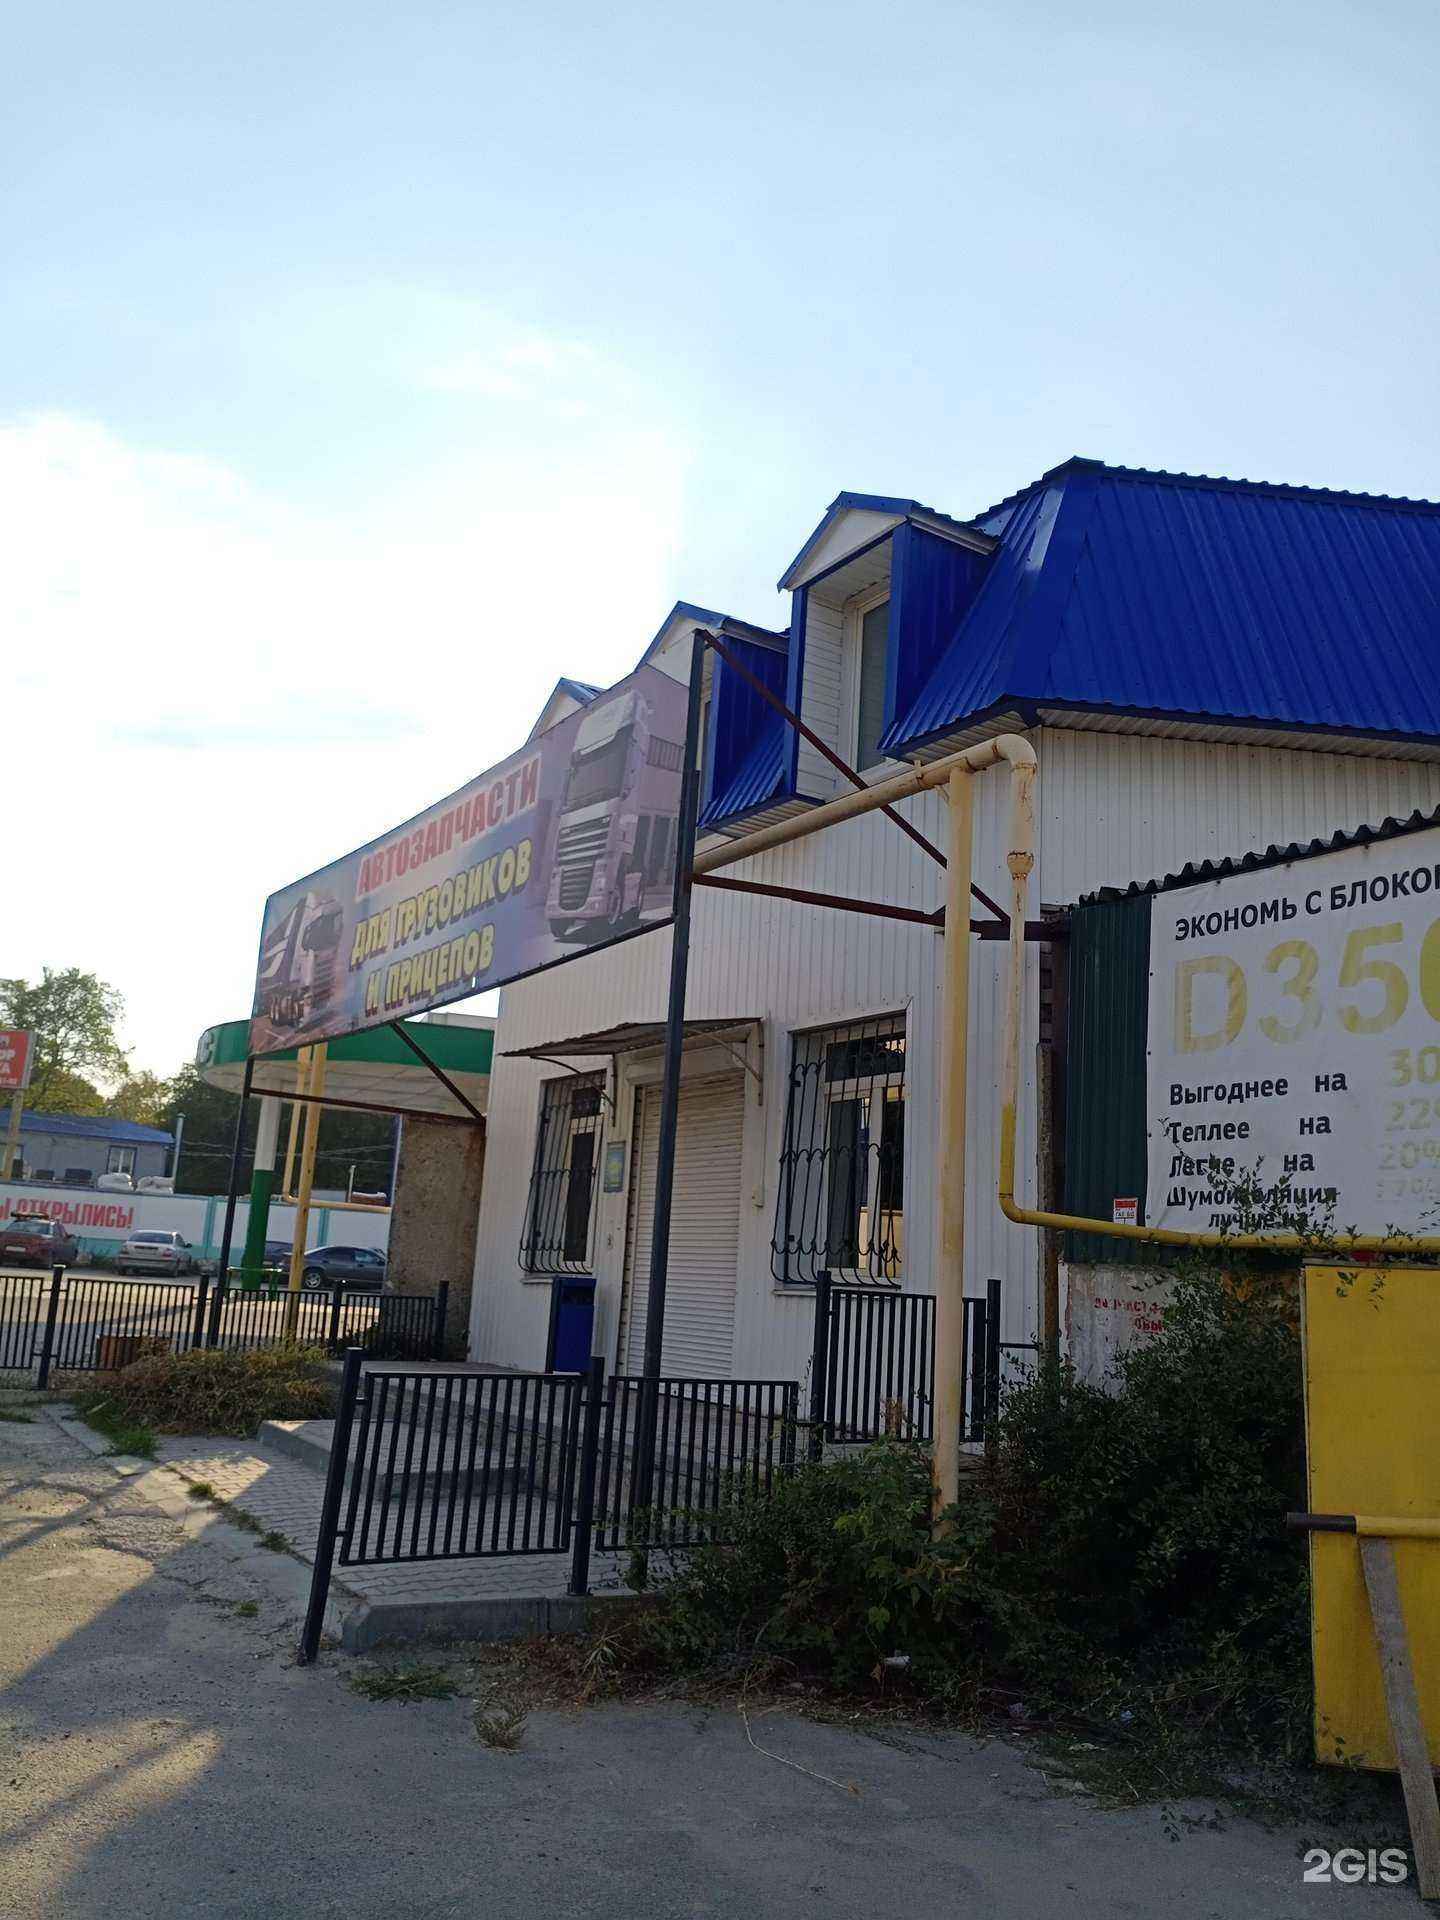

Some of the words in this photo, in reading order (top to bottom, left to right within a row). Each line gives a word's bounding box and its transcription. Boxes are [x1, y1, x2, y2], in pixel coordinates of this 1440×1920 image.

[356, 756, 541, 900] АВТОЗАПЧАСТИ
[350, 907, 392, 971] ДЛЯ
[394, 838, 532, 948] ГРУЗОВИКОВ
[1174, 896, 1298, 941] ЭКОНОМЬ
[1305, 890, 1322, 915] С
[1330, 864, 1440, 911] БЛОКО
[365, 968, 382, 1018] И
[384, 922, 496, 1011] ПРИЦЕПОВ
[1169, 1077, 1289, 1106] Выгоднее
[1314, 1072, 1348, 1093] на
[1168, 1120, 1250, 1144] Теплее
[1299, 1115, 1332, 1136] на
[1283, 1153, 1316, 1172] на
